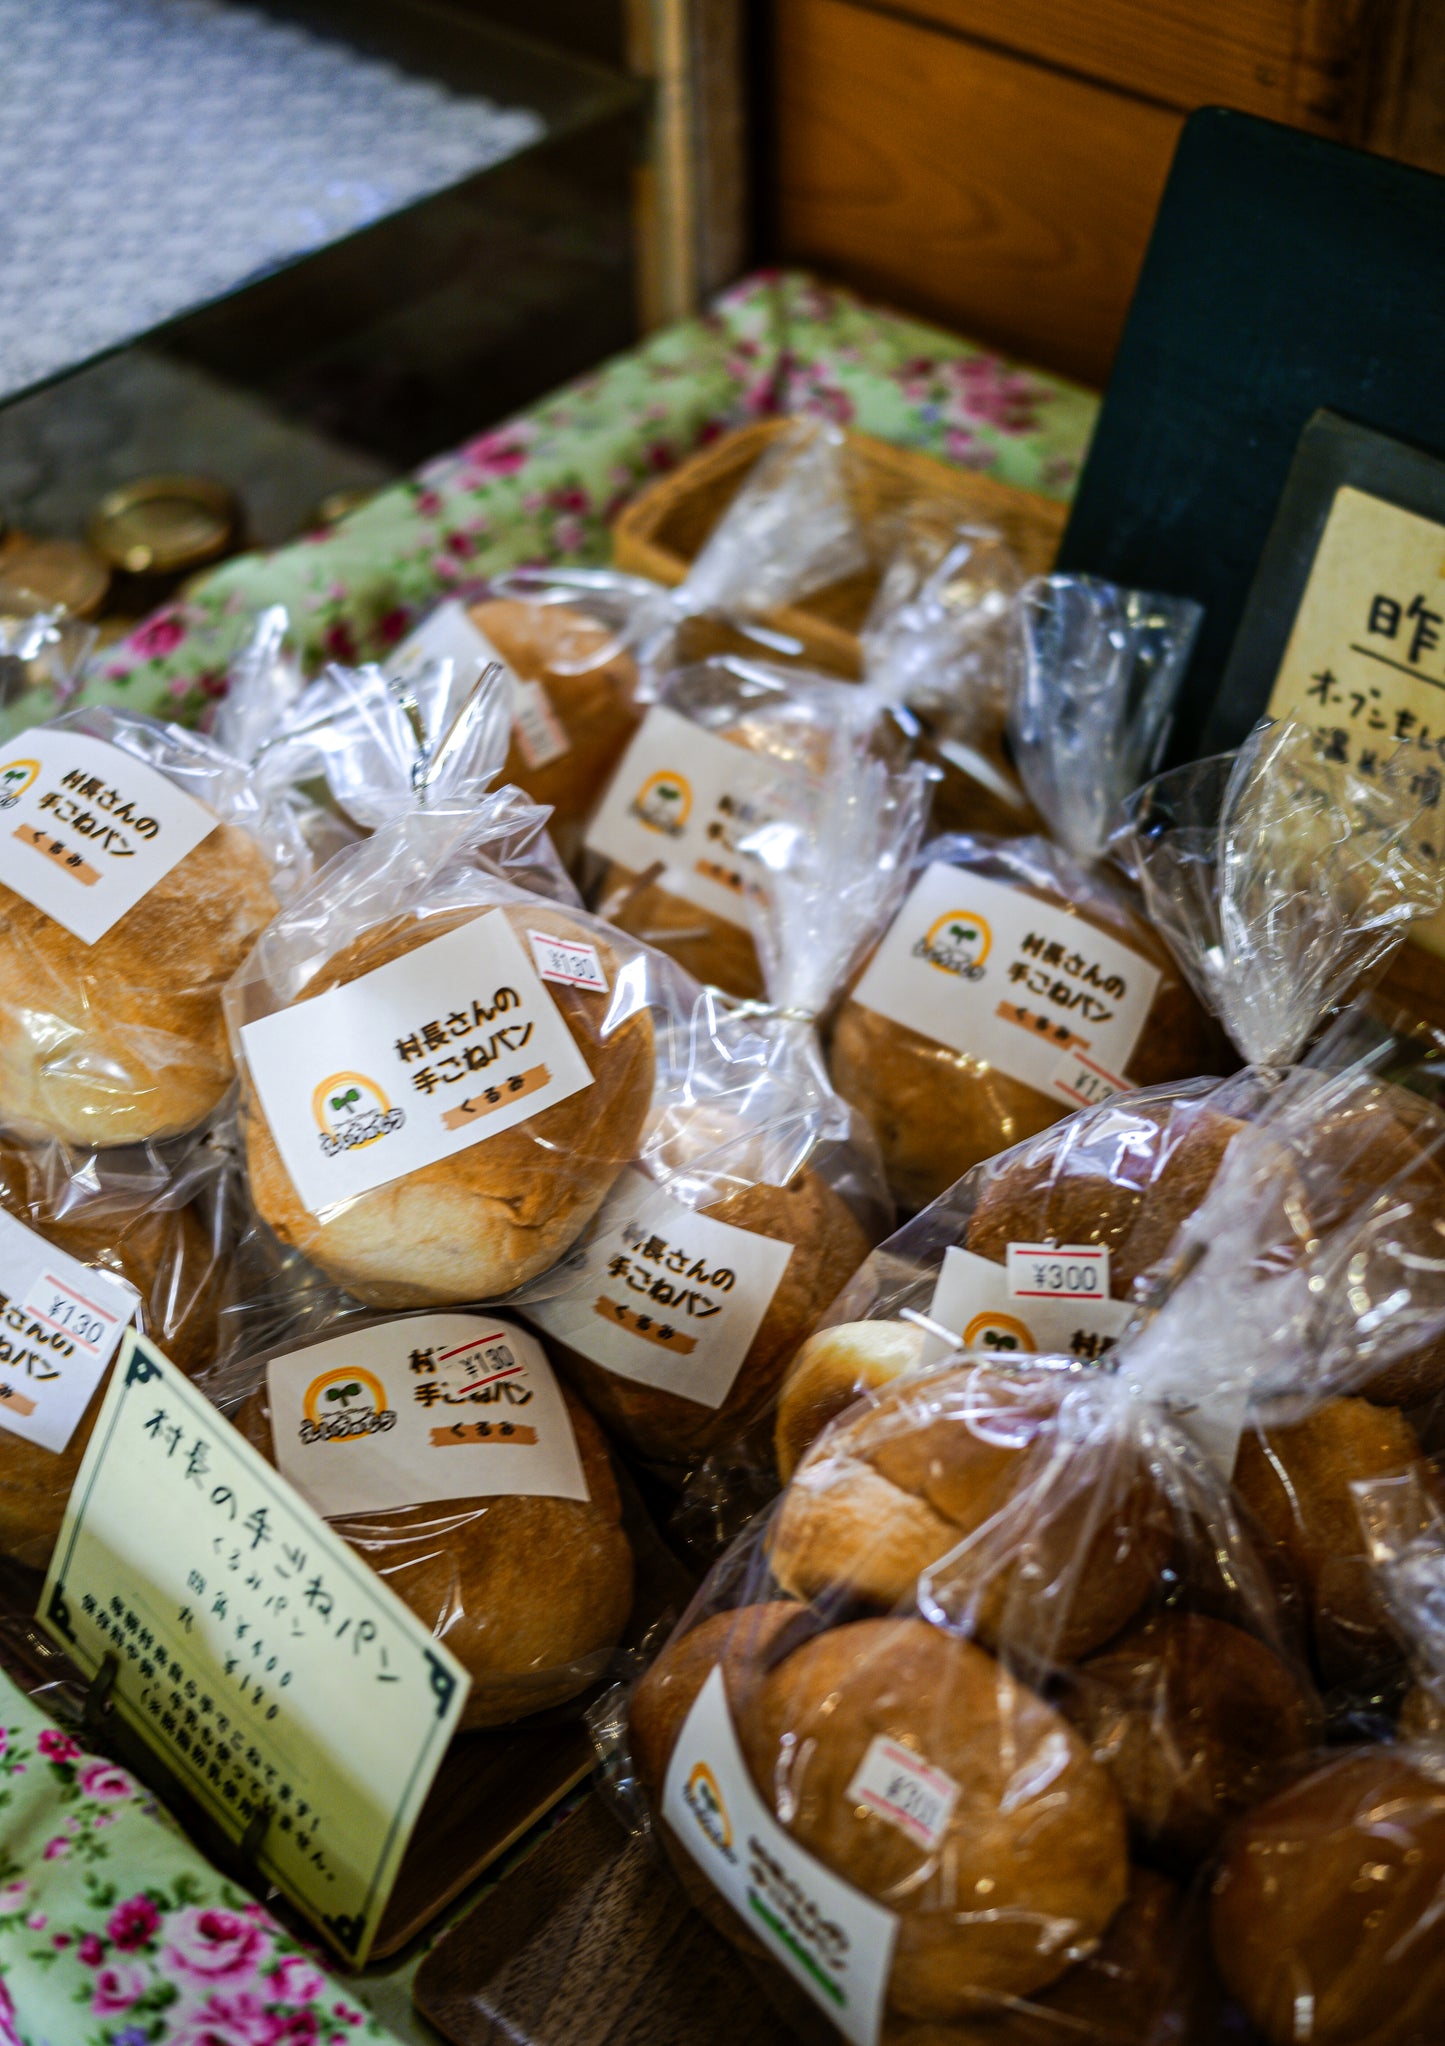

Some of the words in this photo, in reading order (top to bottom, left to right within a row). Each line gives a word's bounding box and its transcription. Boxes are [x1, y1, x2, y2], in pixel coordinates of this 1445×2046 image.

[38, 791, 137, 856] 手こねパン
[60, 768, 161, 841] 村長さんの
[32, 830, 84, 868] くるみ
[549, 948, 598, 980] ¥130
[1021, 931, 1127, 1000] 村長さんの
[1007, 961, 1114, 1024] 手こねパン
[394, 986, 521, 1063] 村長さんの
[411, 1021, 535, 1094] 手こねパン
[460, 1074, 525, 1114] くるみ
[608, 1253, 722, 1318] 手こねパン
[1033, 1263, 1098, 1291] ¥300
[48, 1295, 105, 1344] ¥130
[614, 1304, 676, 1341] くるみ
[458, 1344, 515, 1380] ¥130
[449, 1419, 516, 1439] くるみ
